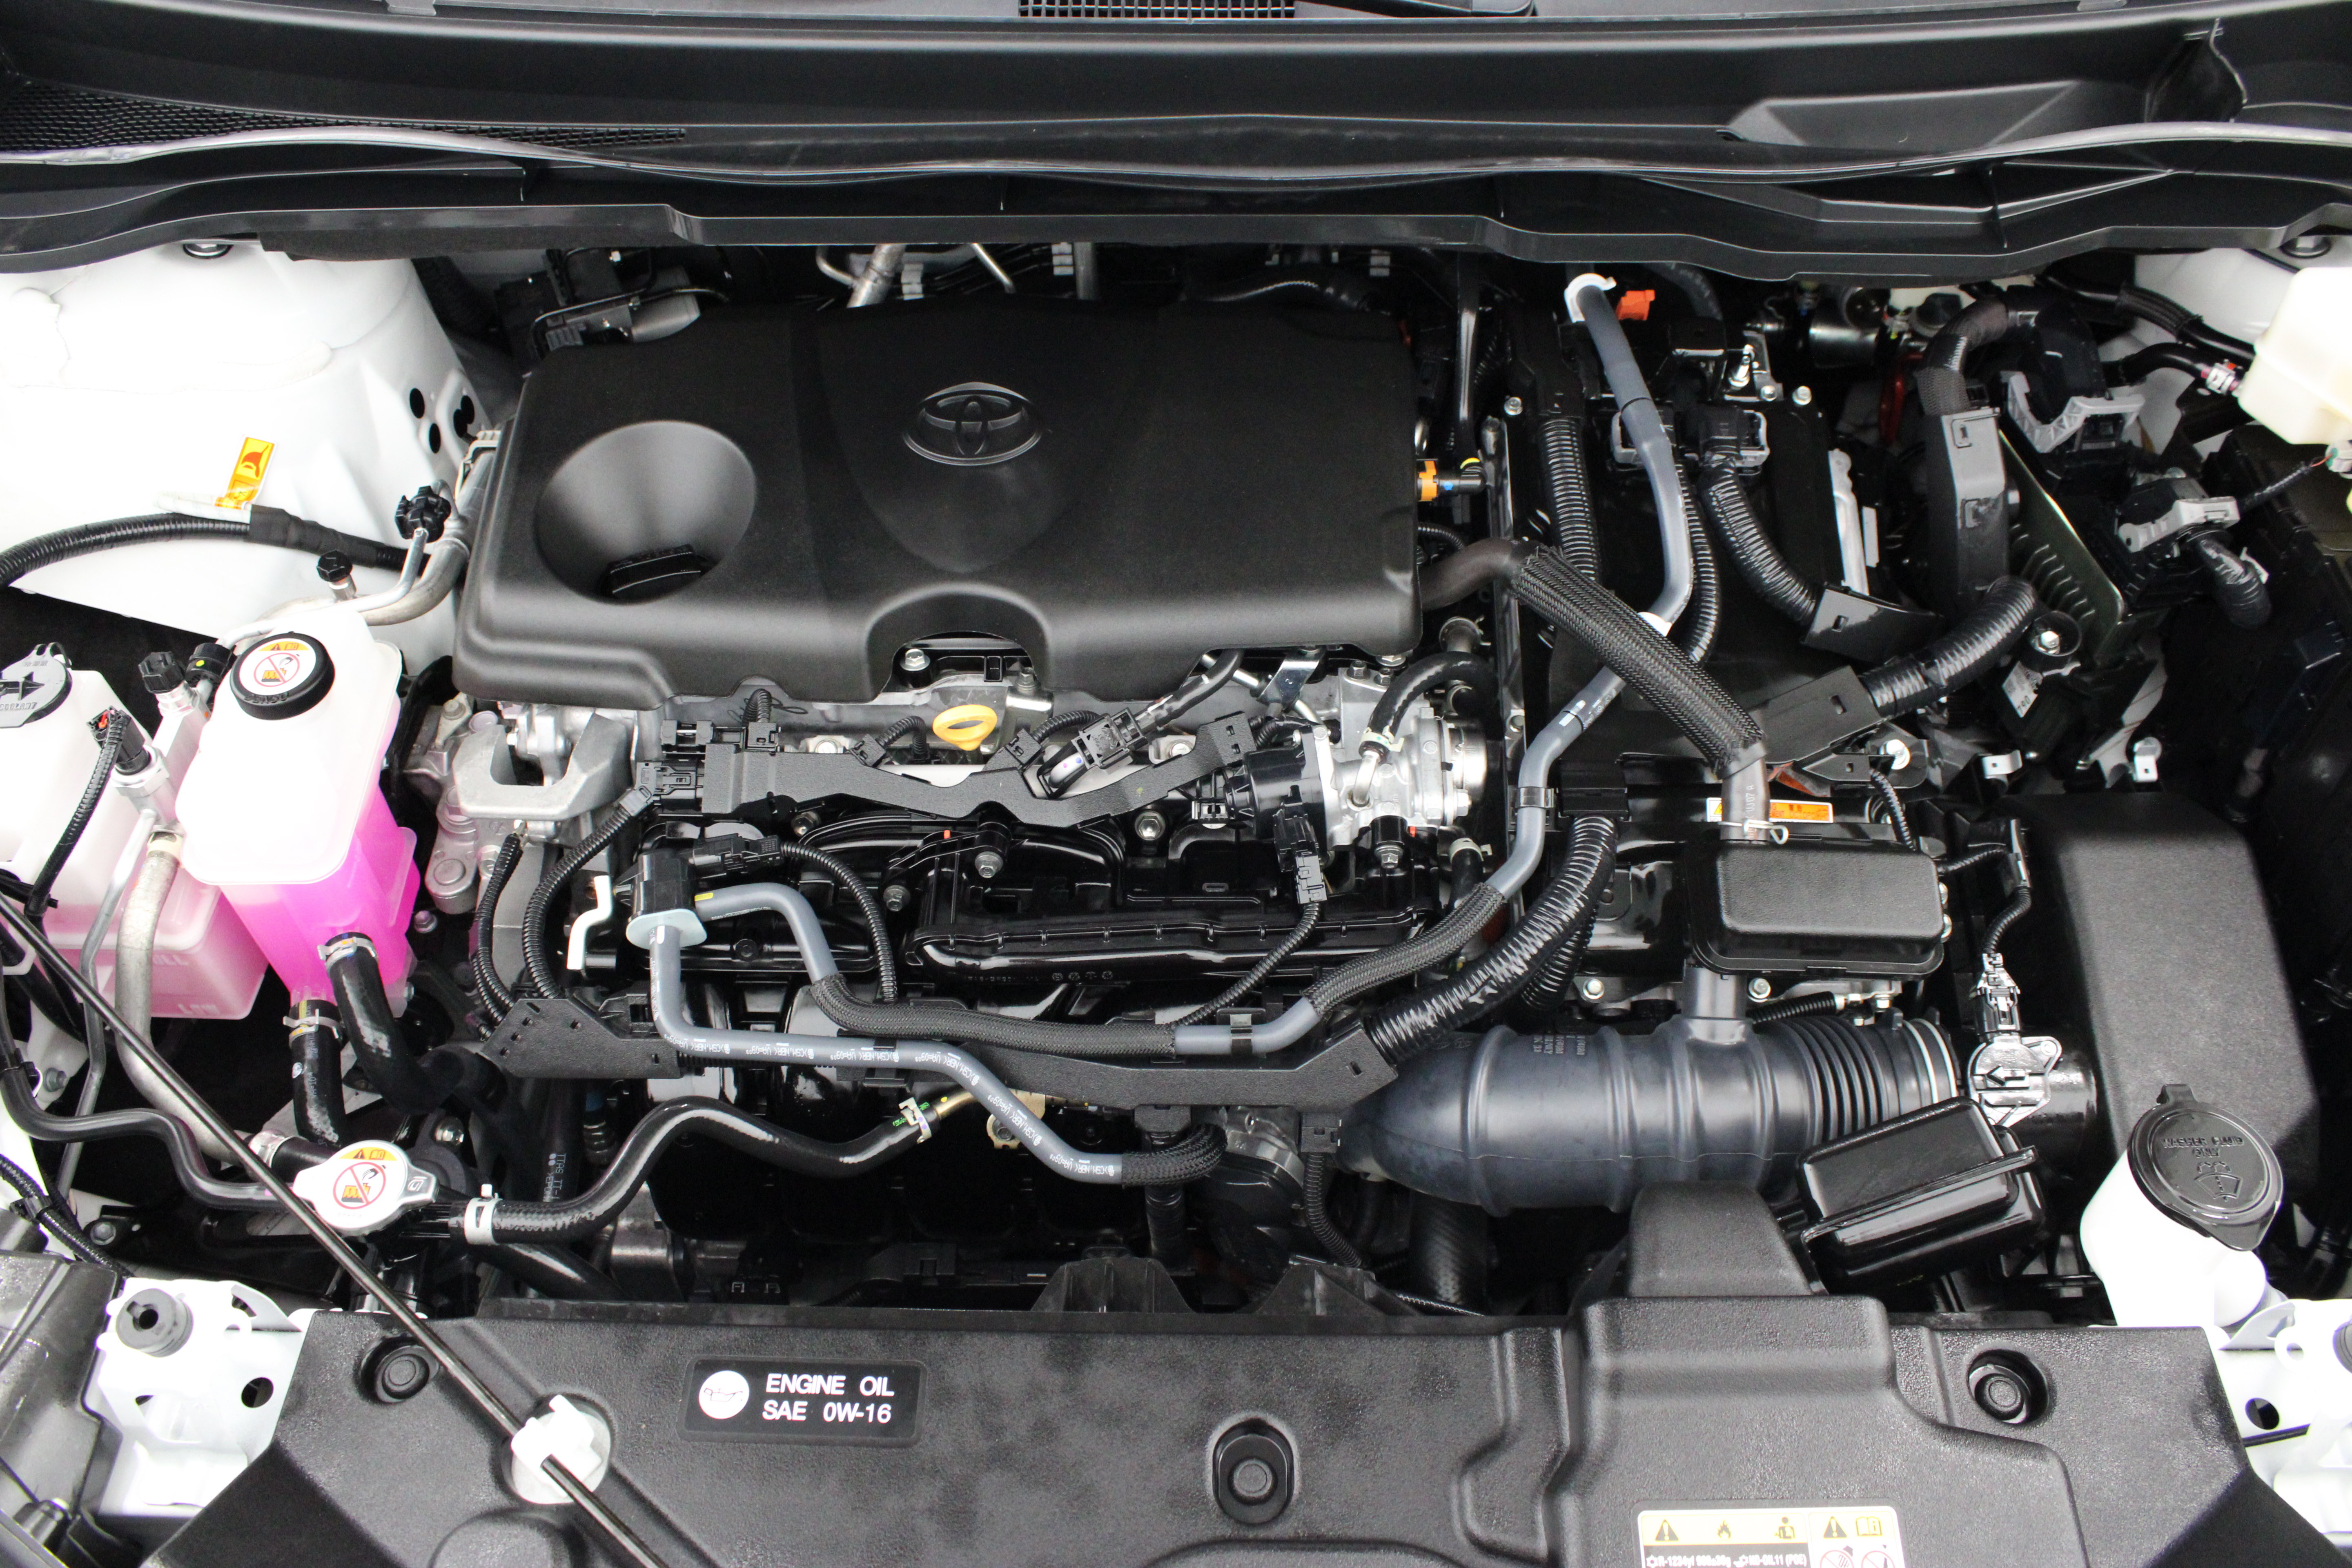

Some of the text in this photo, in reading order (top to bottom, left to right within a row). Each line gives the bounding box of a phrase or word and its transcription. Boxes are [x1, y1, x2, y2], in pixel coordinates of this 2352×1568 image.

[244, 693, 289, 704] DENSO
[0, 702, 38, 711] COOLANT
[2162, 1136, 2244, 1149] WASHER FLUID
[2193, 1148, 2221, 1158] ONLY
[766, 1373, 894, 1396] ENGINE OIL
[762, 1400, 892, 1424] SAE 0W-16
